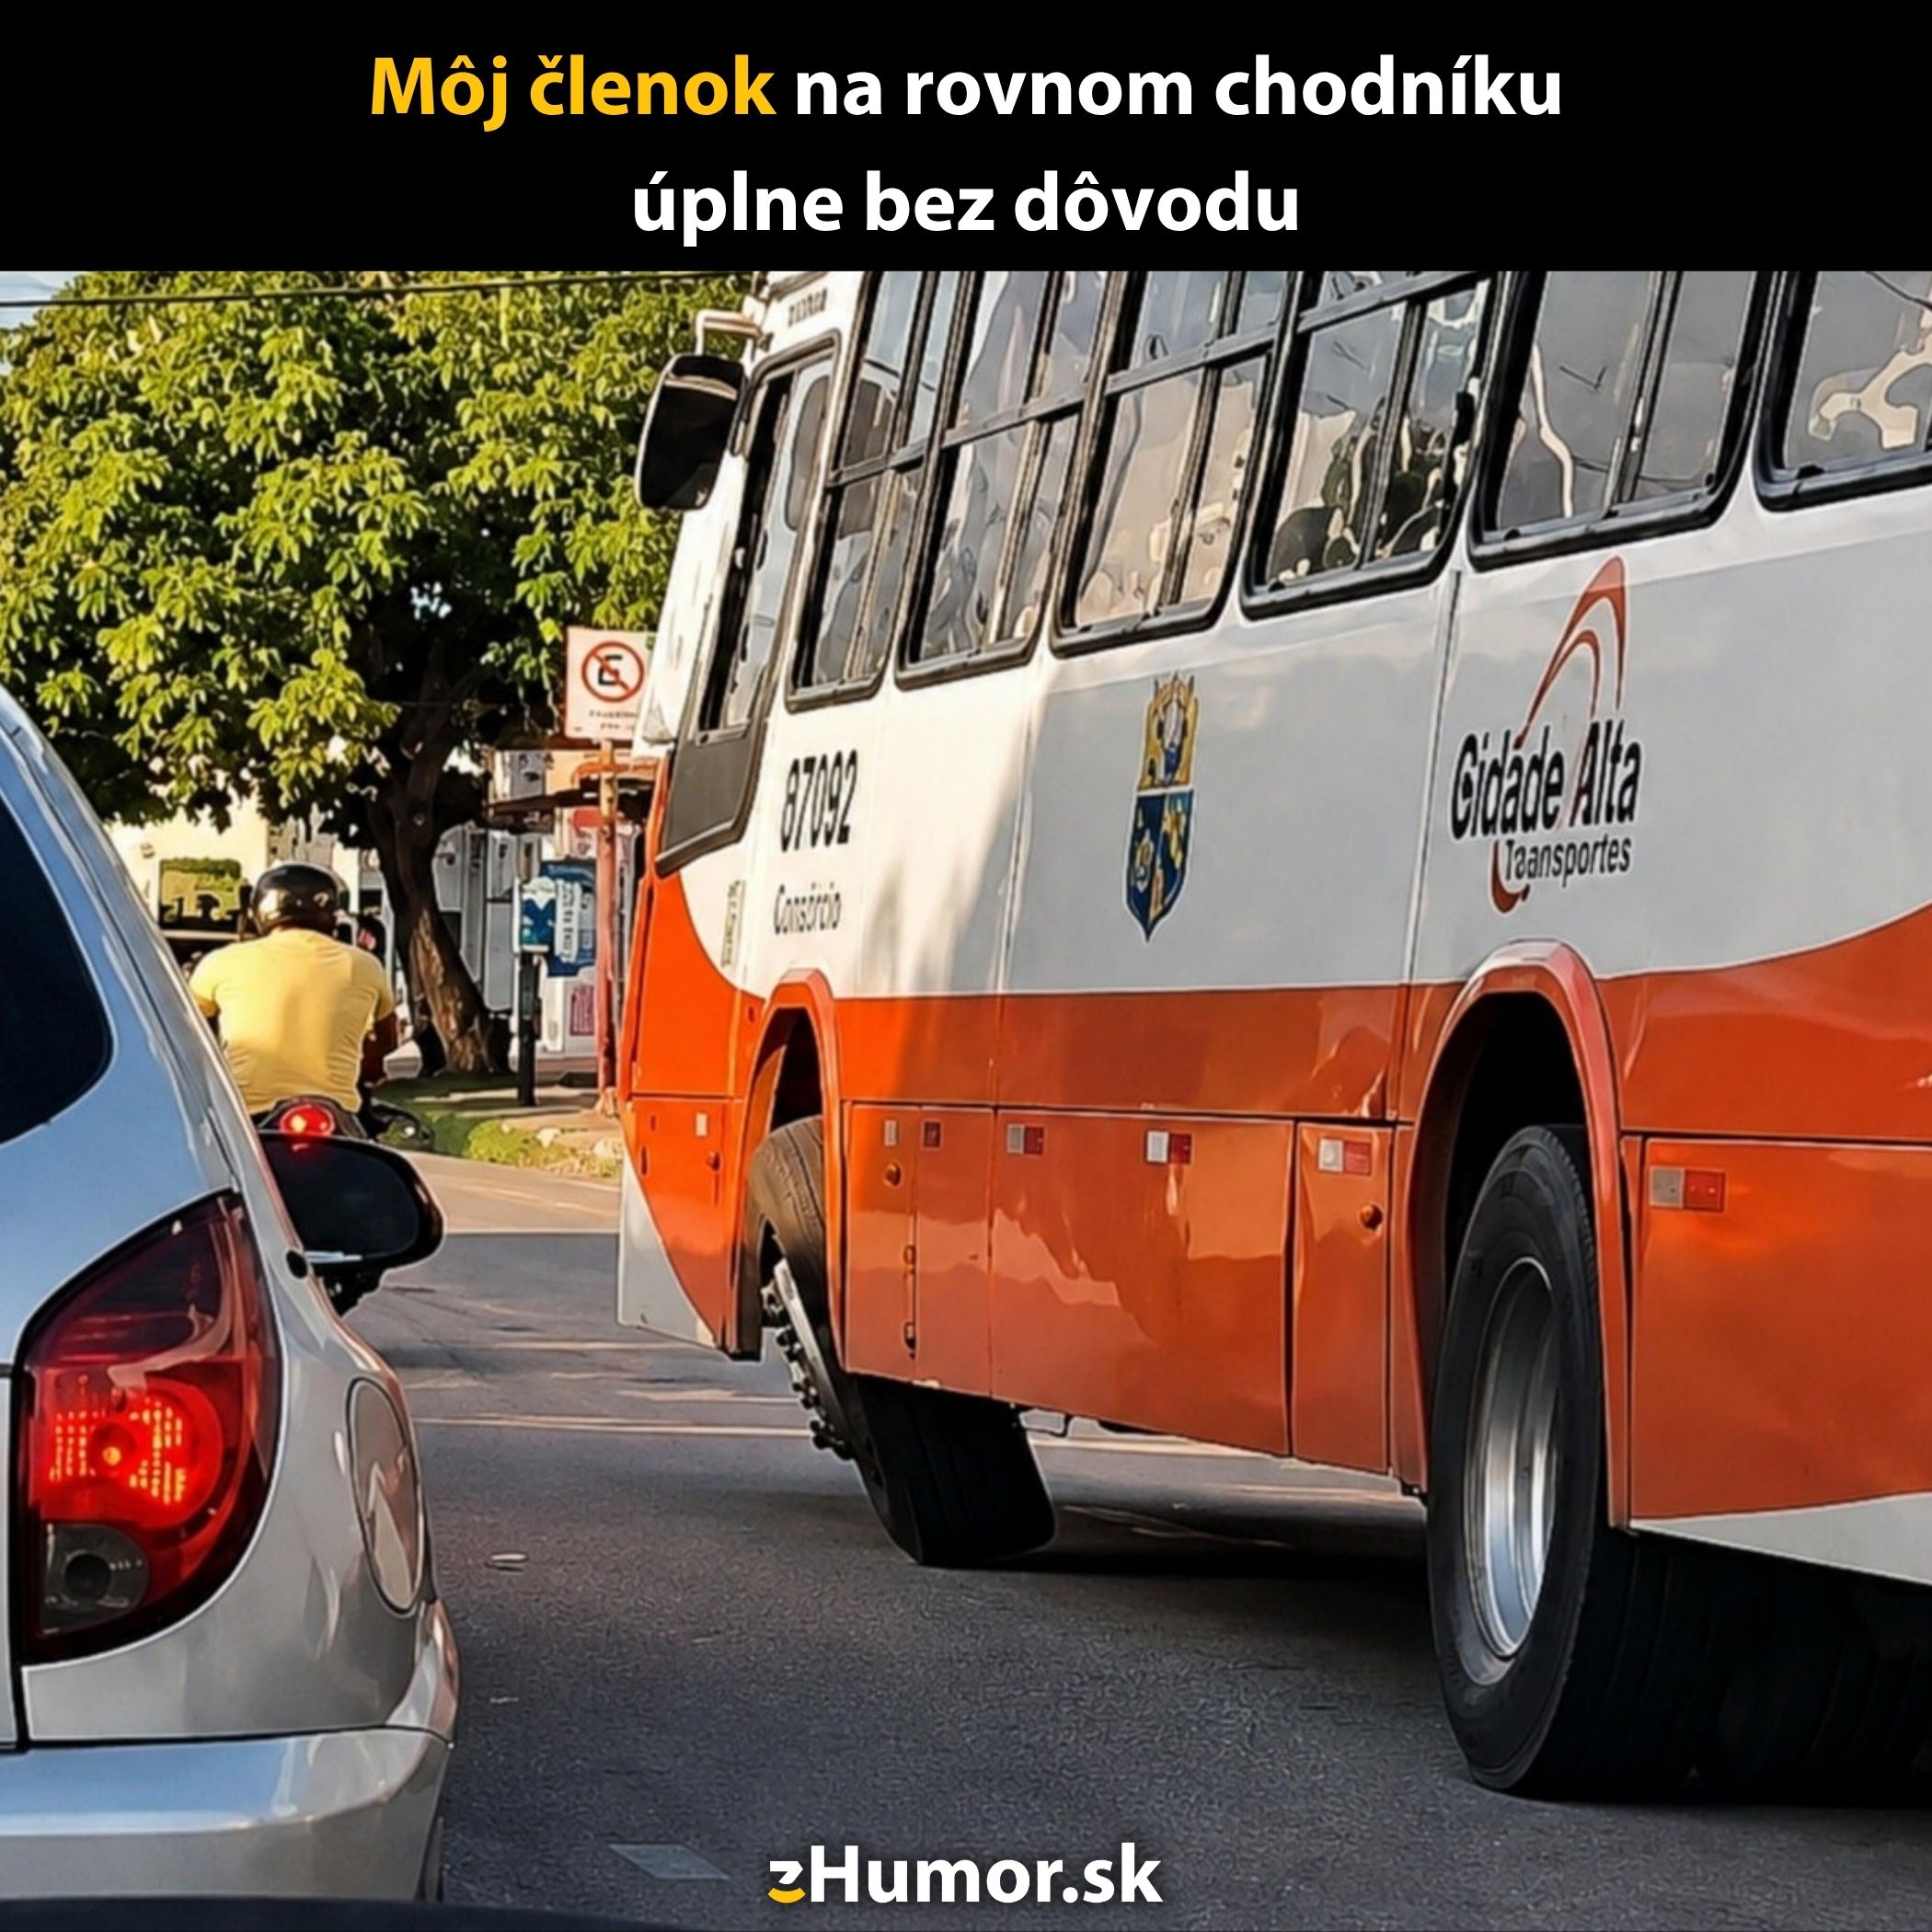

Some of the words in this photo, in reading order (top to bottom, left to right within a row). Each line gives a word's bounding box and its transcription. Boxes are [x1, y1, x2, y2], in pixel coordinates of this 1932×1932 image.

[780, 749, 857, 852] 87092
[1451, 724, 1565, 840] Cidade
[1568, 719, 1641, 828] Alta
